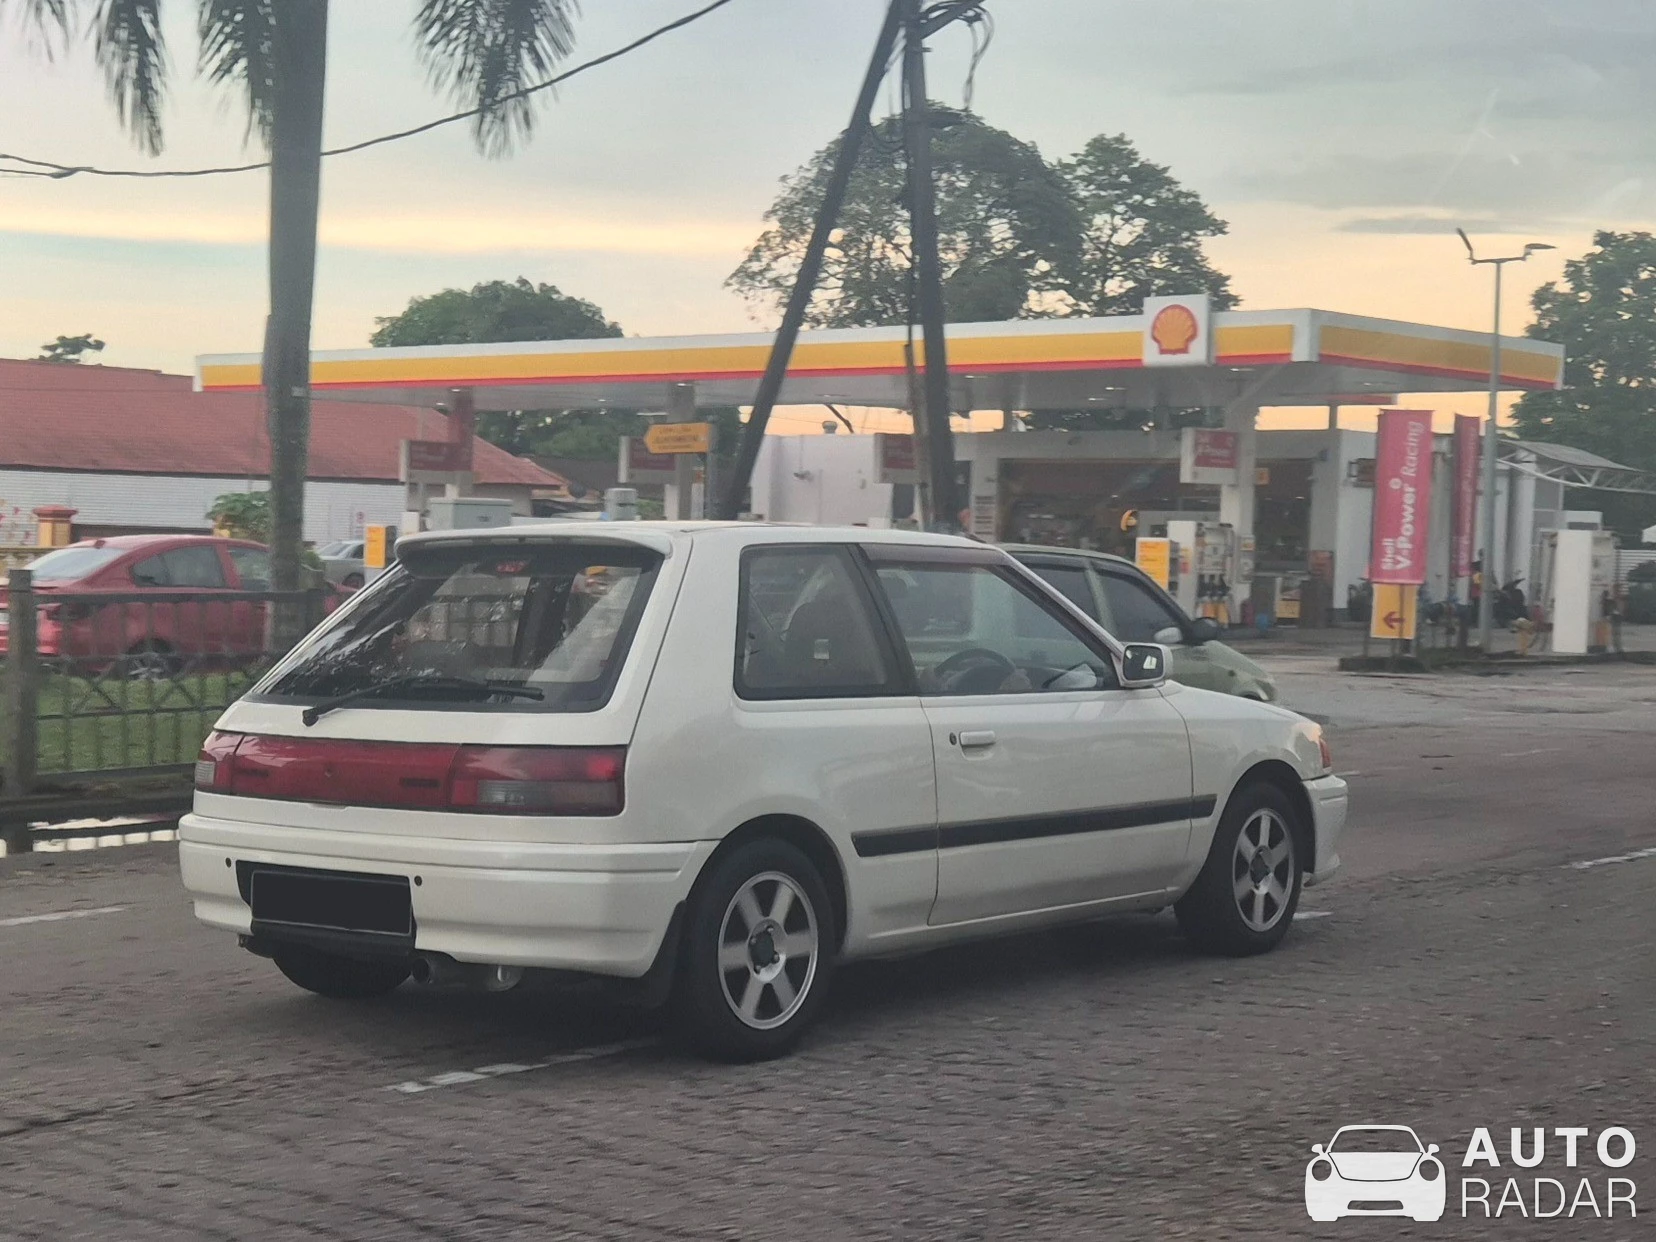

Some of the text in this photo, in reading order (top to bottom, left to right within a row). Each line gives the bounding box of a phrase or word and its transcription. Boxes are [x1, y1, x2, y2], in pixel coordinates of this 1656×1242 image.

[1396, 421, 1425, 570] V-Power Racing
[1381, 538, 1395, 570] Shell
